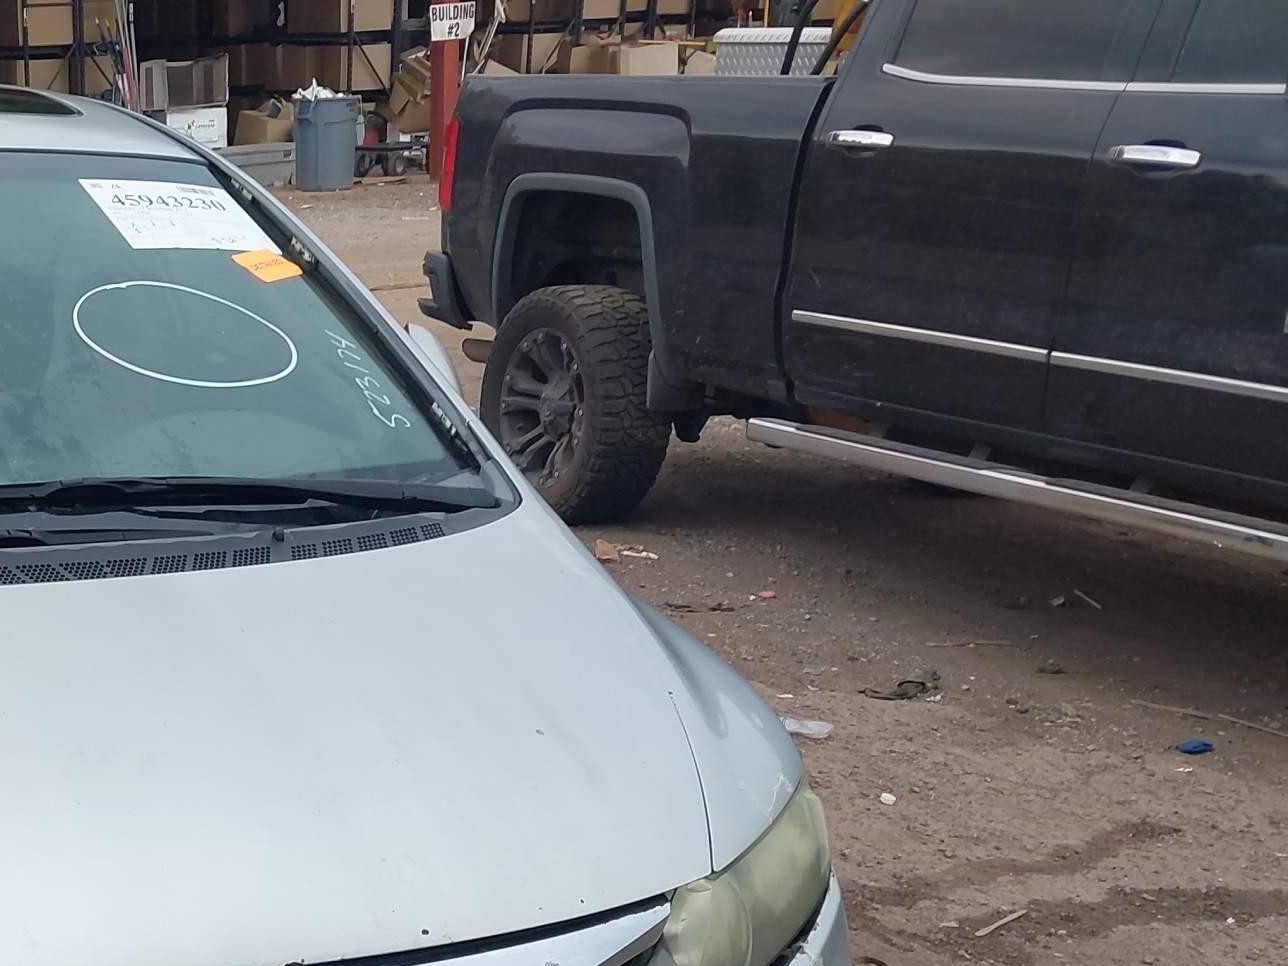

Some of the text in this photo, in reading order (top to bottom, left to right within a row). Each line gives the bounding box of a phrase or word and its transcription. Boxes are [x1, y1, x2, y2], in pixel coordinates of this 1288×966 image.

[431, 3, 475, 22] BUILDING
[447, 22, 460, 37] #2
[111, 192, 227, 213] 45943230
